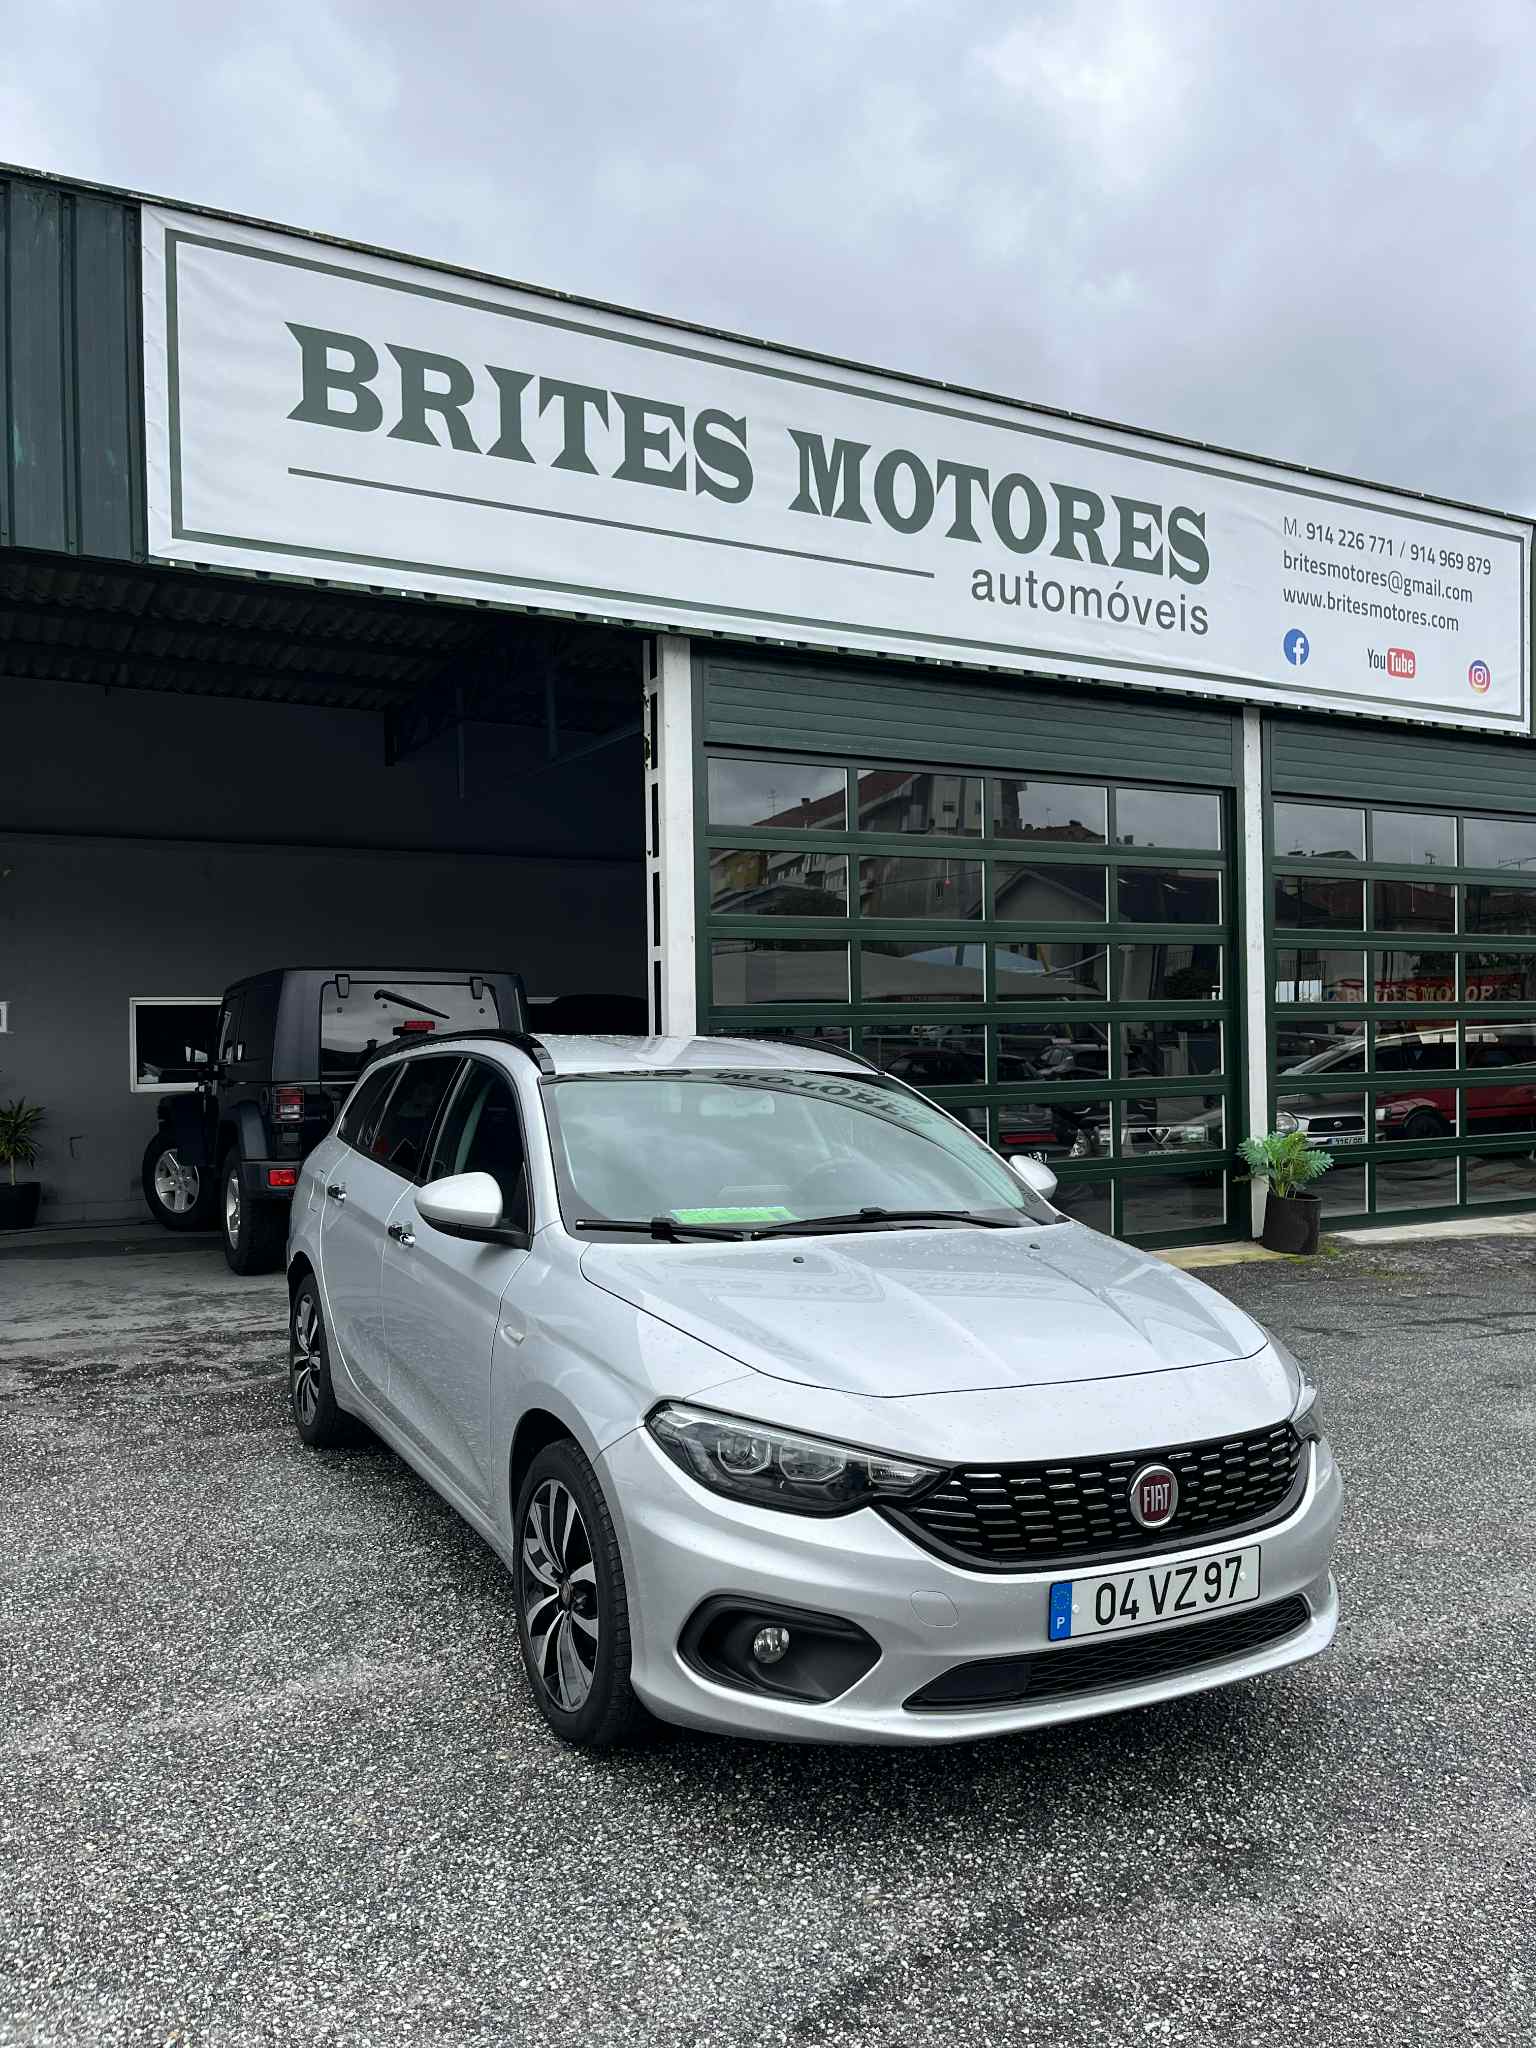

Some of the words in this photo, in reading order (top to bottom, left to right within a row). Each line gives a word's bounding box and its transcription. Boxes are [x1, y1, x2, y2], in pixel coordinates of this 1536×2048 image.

[284, 321, 753, 504] BRITES
[786, 428, 1210, 585] MOTORES
[1283, 516, 1302, 538] M.
[1306, 522, 1334, 545] 914
[1338, 529, 1365, 550] 226
[1368, 535, 1393, 557] 771
[1399, 541, 1407, 559] /
[1410, 544, 1435, 565] 914
[1439, 550, 1464, 570] 969
[1467, 555, 1491, 575] 879
[971, 568, 1208, 636] automóveis
[1283, 550, 1473, 603] britesmotores@gmail.com
[1283, 587, 1459, 632] www.britesmotores.com
[1143, 1482, 1170, 1513] FIAT
[1056, 1616, 1065, 1630] P
